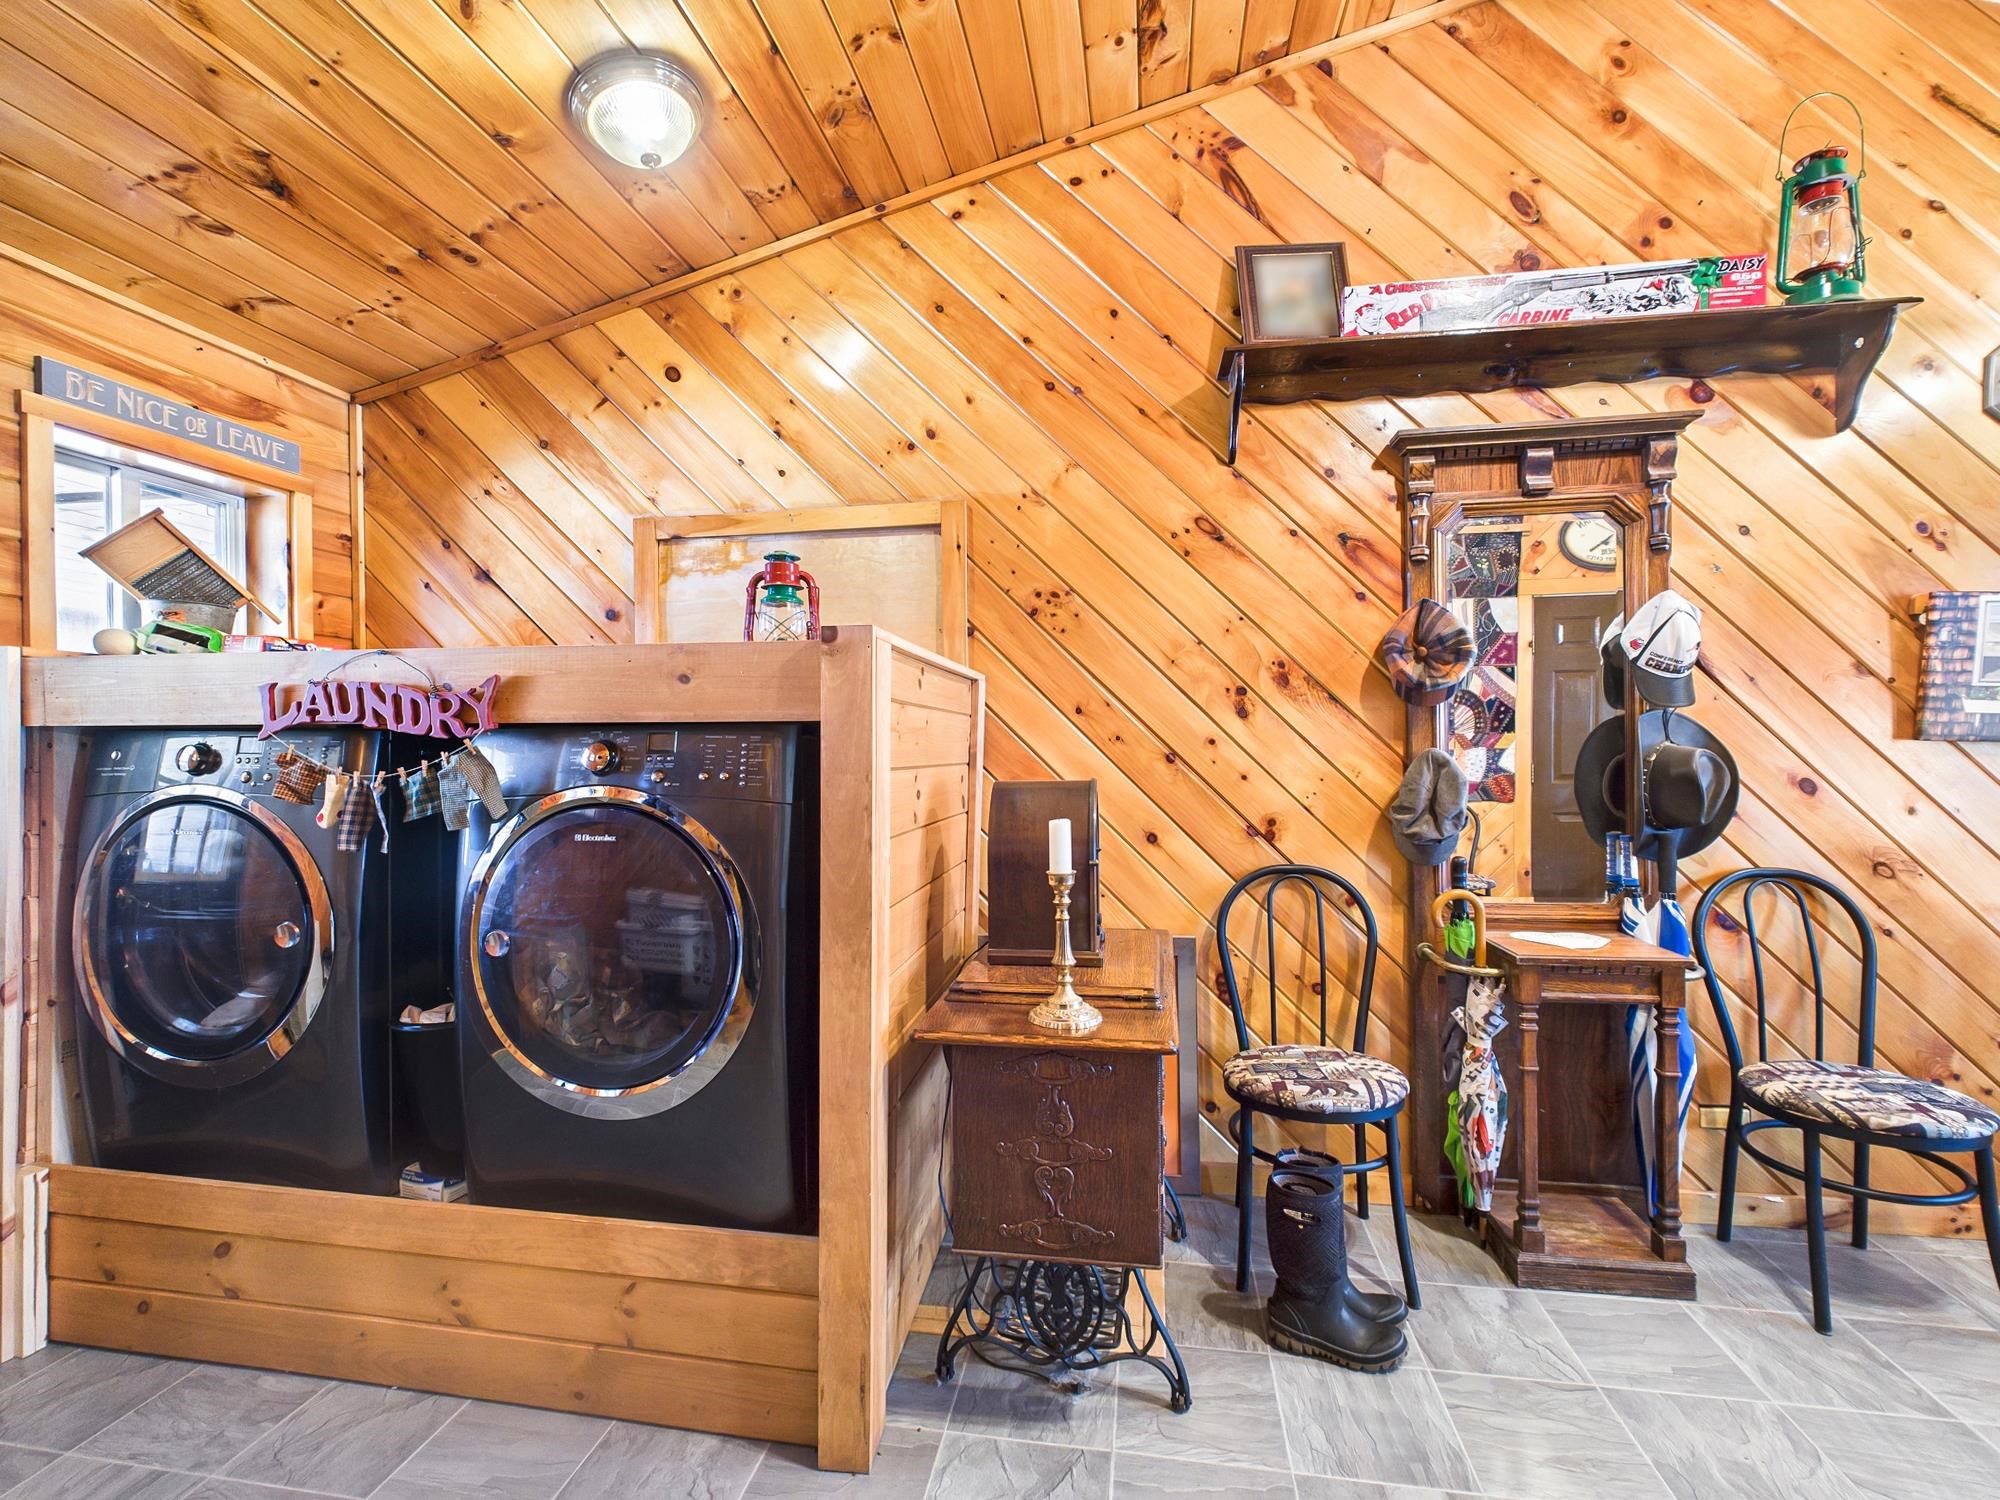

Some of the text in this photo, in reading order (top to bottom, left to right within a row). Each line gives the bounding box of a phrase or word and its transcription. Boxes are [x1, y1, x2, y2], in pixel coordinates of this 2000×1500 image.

[1717, 257, 1766, 272] DAISY
[1369, 284, 1384, 296] A
[1385, 302, 1425, 330] RED
[1496, 308, 1574, 326] CARBINE
[65, 370, 105, 408] BE
[116, 387, 179, 431] NICE
[216, 421, 286, 464] LEAVE
[258, 674, 500, 740] LAUNDRY
